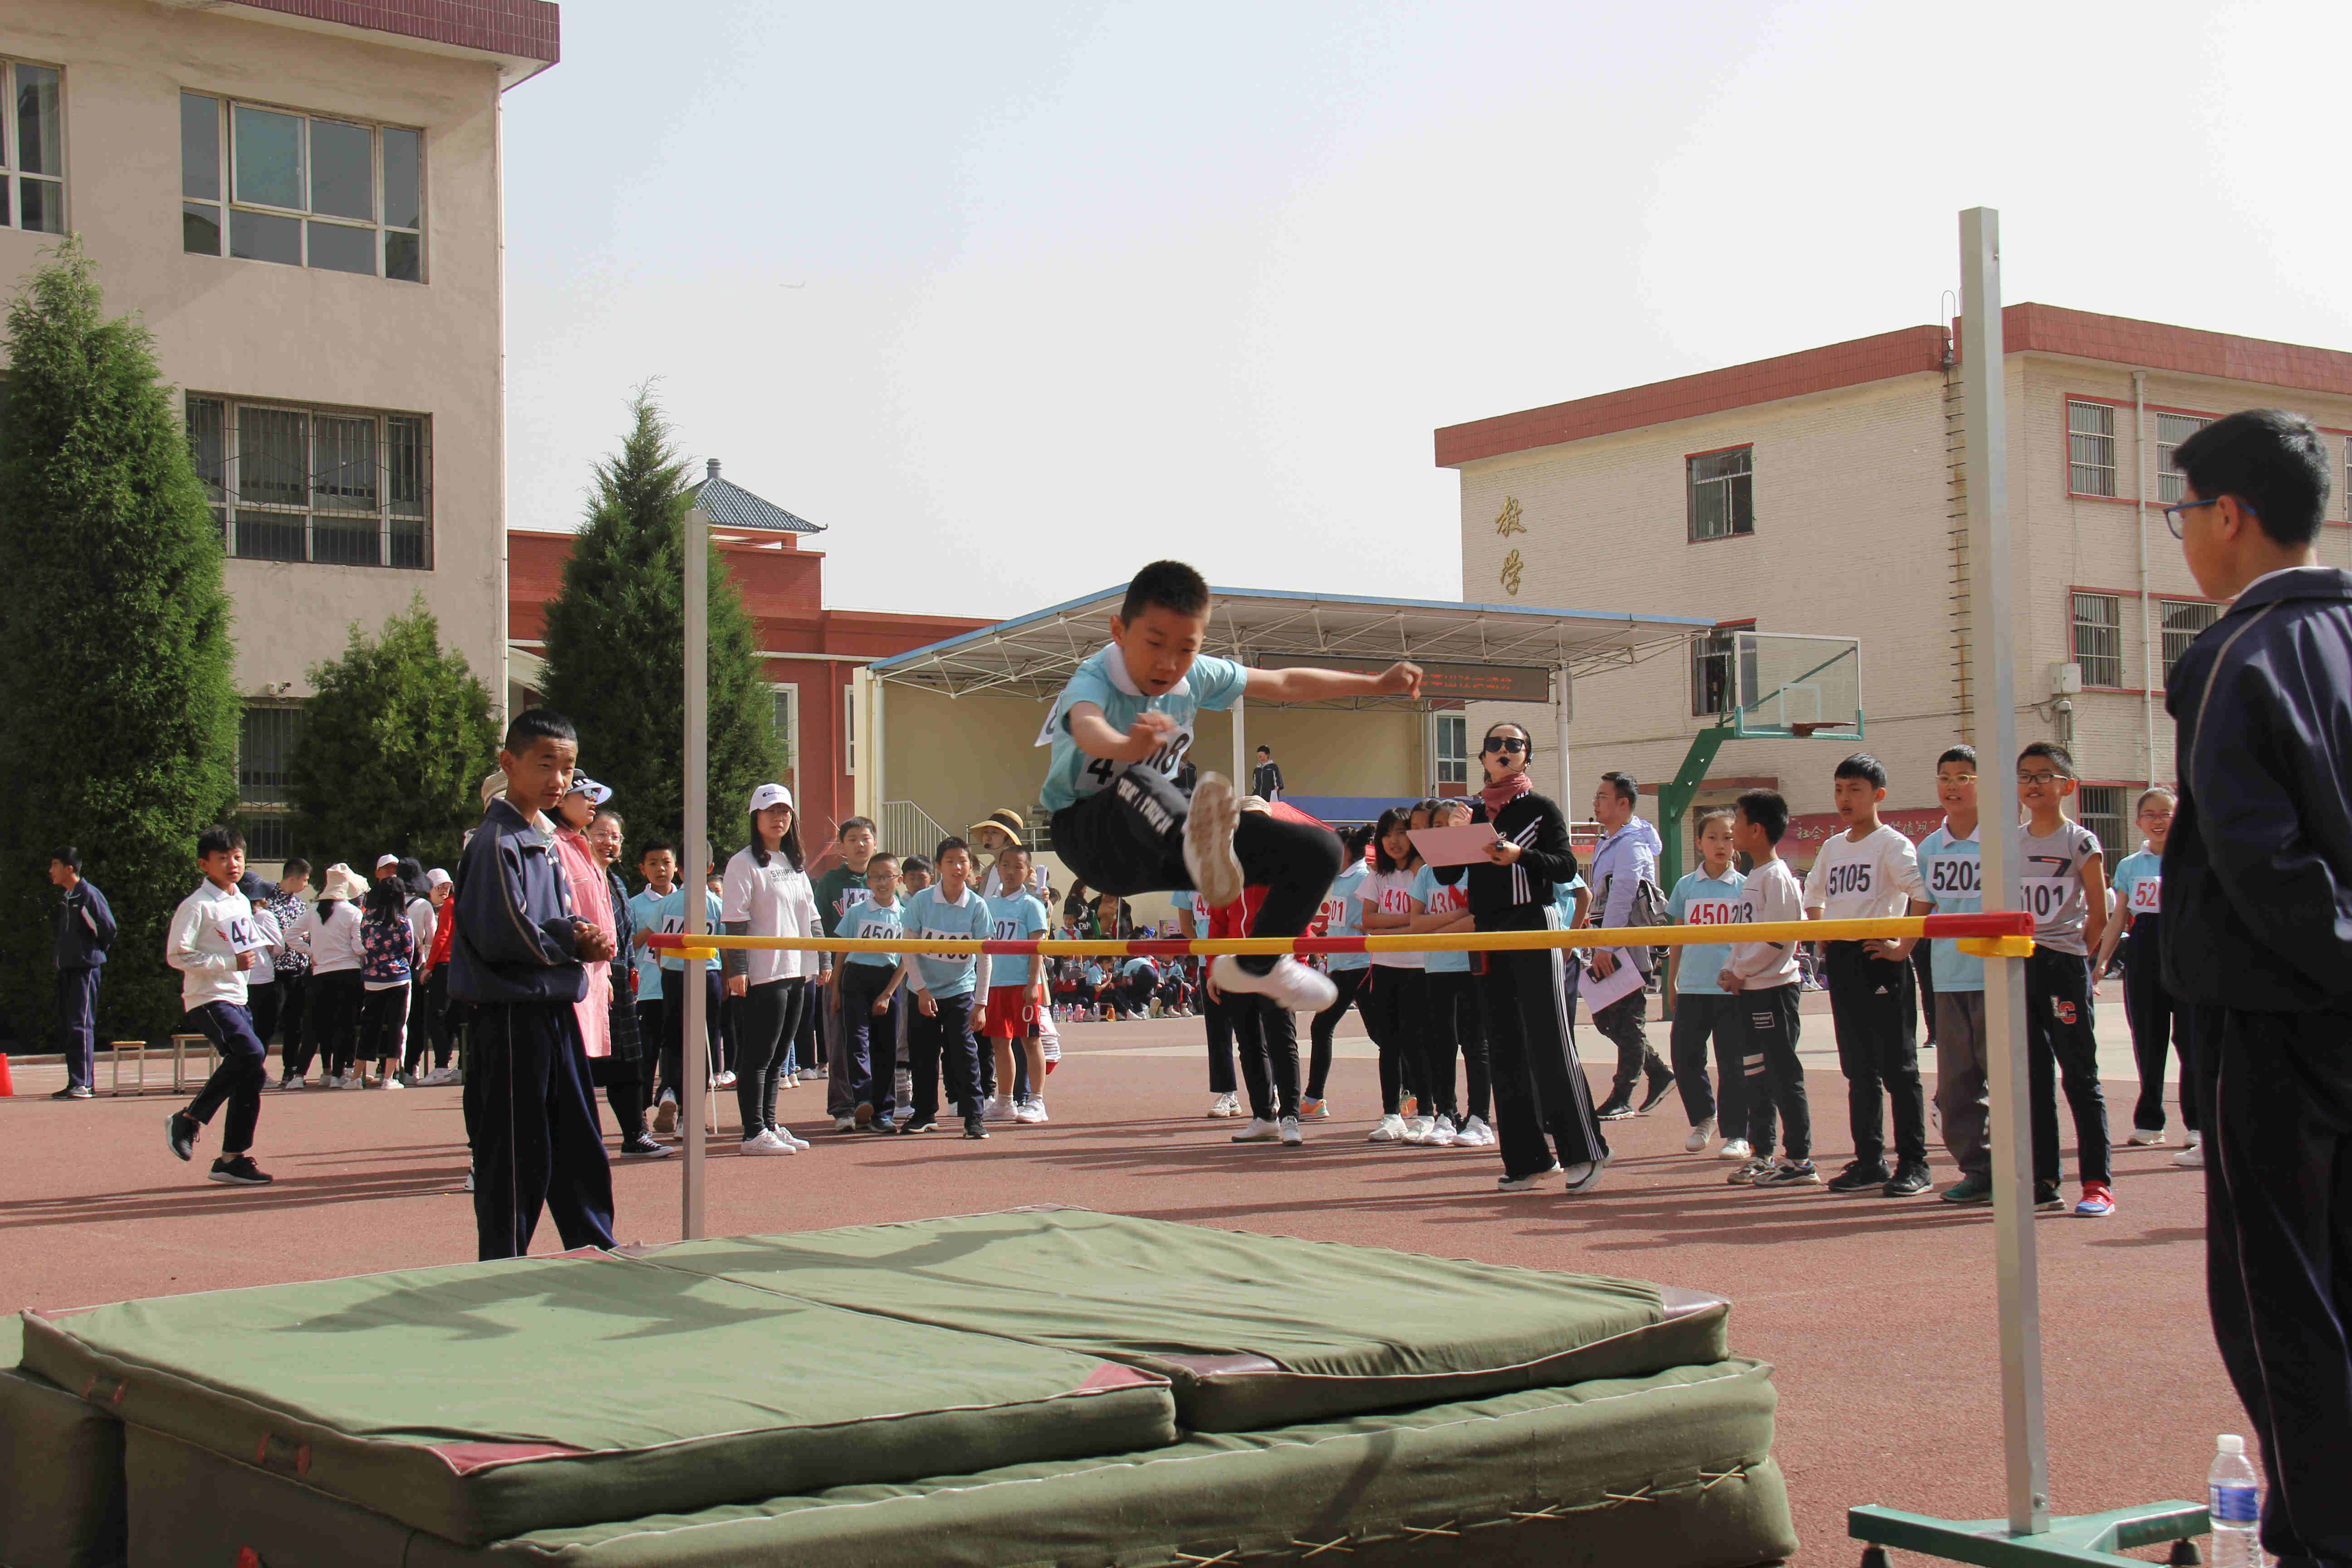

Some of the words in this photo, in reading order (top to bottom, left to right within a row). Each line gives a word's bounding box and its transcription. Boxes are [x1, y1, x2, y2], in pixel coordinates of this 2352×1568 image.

[1829, 864, 1871, 895] 5105
[2020, 885, 2063, 916] 101
[2135, 882, 2161, 906] 52
[1328, 900, 1343, 922] 01
[1690, 903, 1729, 925] 450
[992, 921, 1016, 940] 07
